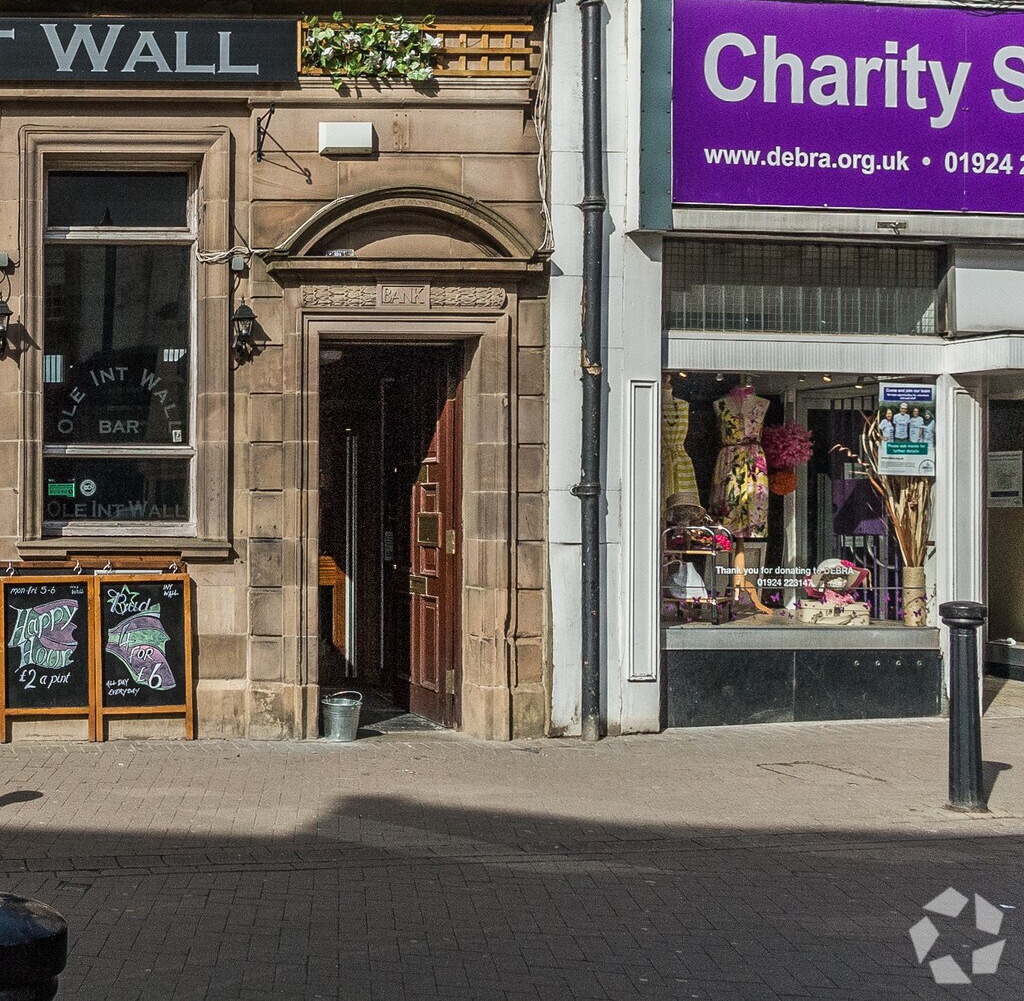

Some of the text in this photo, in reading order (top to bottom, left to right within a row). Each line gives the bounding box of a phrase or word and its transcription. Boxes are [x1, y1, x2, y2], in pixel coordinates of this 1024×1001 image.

[40, 23, 260, 75] WALL
[703, 32, 972, 129] Charity
[704, 145, 910, 175] www.debra.org.uk
[944, 151, 1013, 175] 01924
[382, 287, 425, 305] BANK
[57, 367, 182, 434] OLE INT WALL
[99, 420, 140, 434] BAR
[92, 500, 125, 517] INT
[716, 566, 742, 574] Thank
[743, 567, 759, 576] you
[761, 566, 772, 574] for
[775, 566, 811, 576] donating
[824, 566, 855, 575] DEBRA
[757, 579, 813, 587] 01924 223147
[8, 605, 78, 647] Happy
[17, 636, 74, 668] Hour
[19, 669, 71, 689] £2 a pint
[137, 663, 162, 689] £6
